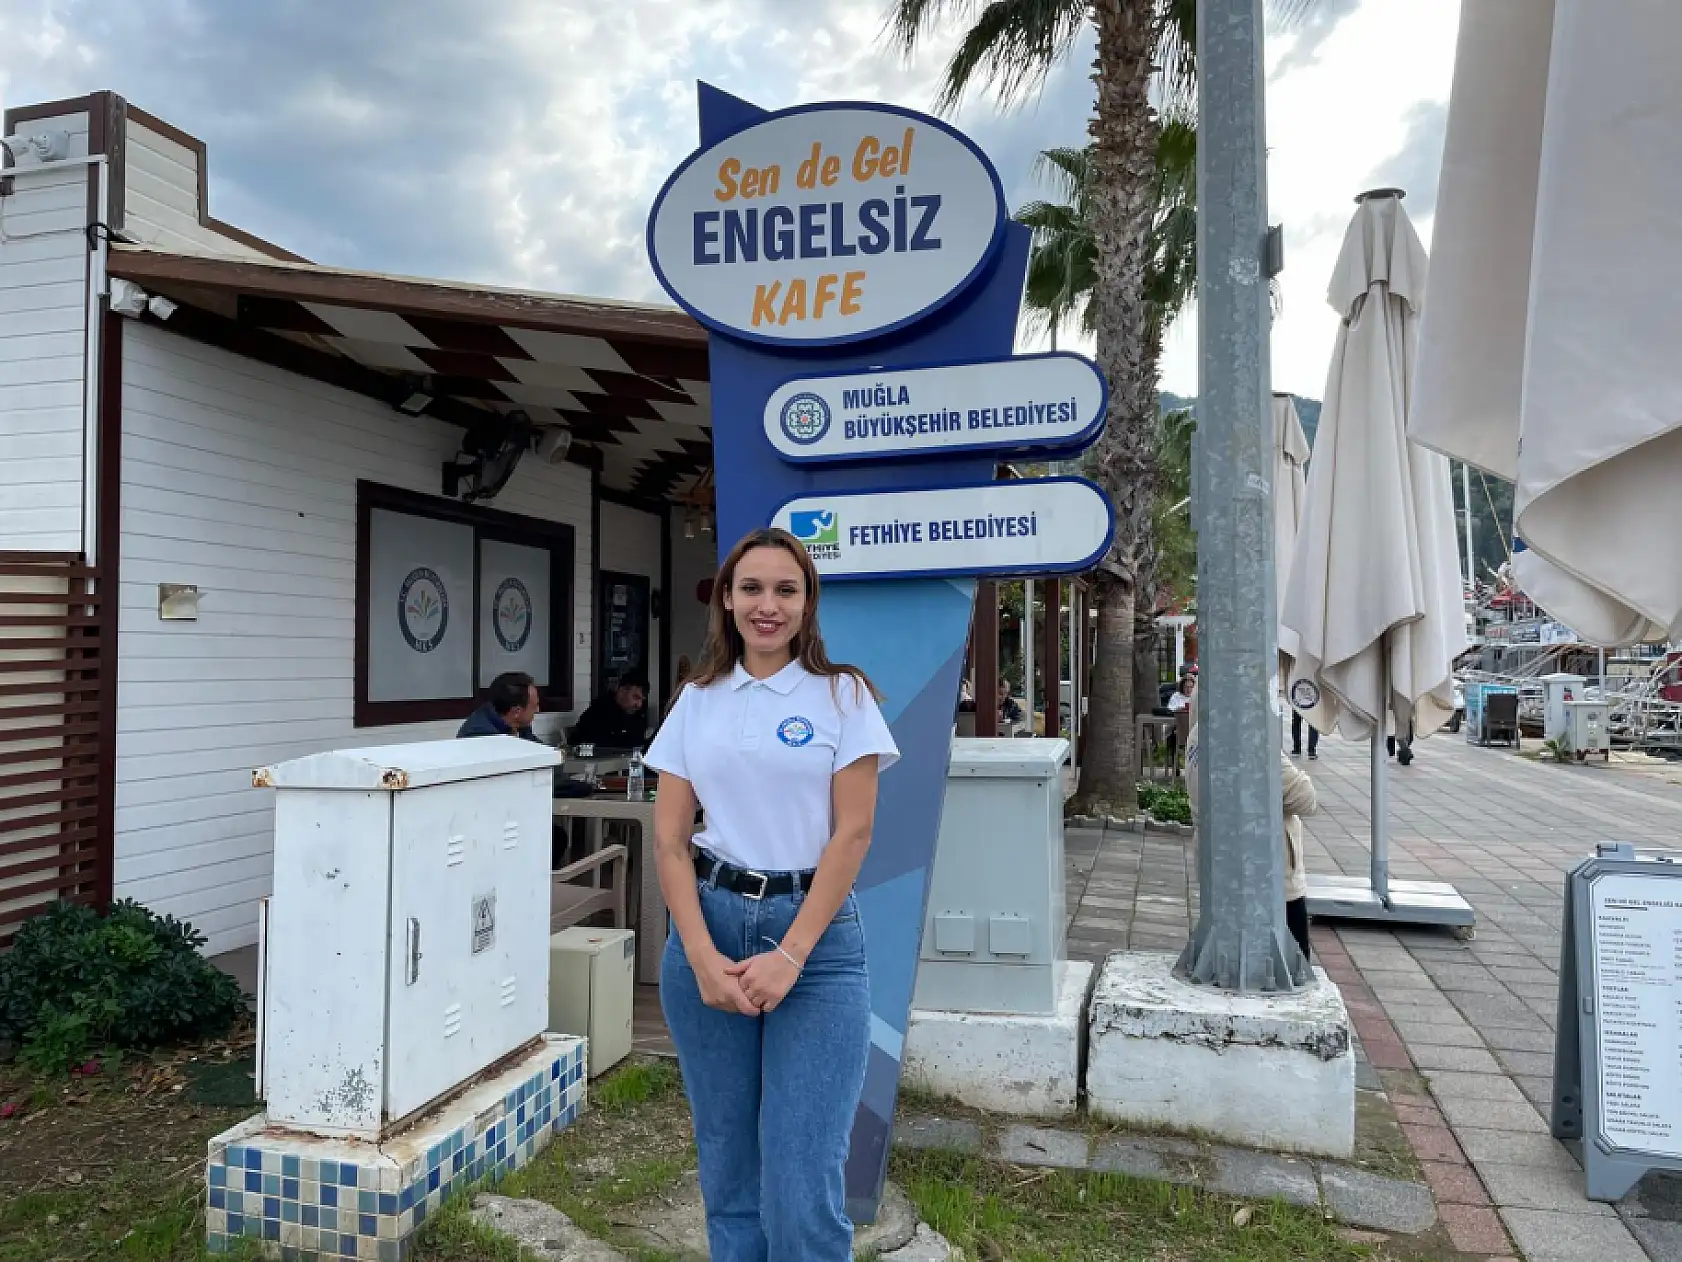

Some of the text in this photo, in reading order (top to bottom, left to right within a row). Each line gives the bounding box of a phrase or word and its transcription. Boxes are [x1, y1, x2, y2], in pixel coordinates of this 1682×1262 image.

[714, 127, 915, 202] Sen de Gel
[693, 185, 942, 266] ENGELSİZ
[752, 271, 866, 327] KAFE
[842, 382, 910, 410] MUĞLA
[844, 408, 962, 440] BÜYÜKŞEHİR
[967, 397, 1077, 429] BELEDİYESİ
[849, 511, 1037, 547] FETHİYE BELEDİYESİ
